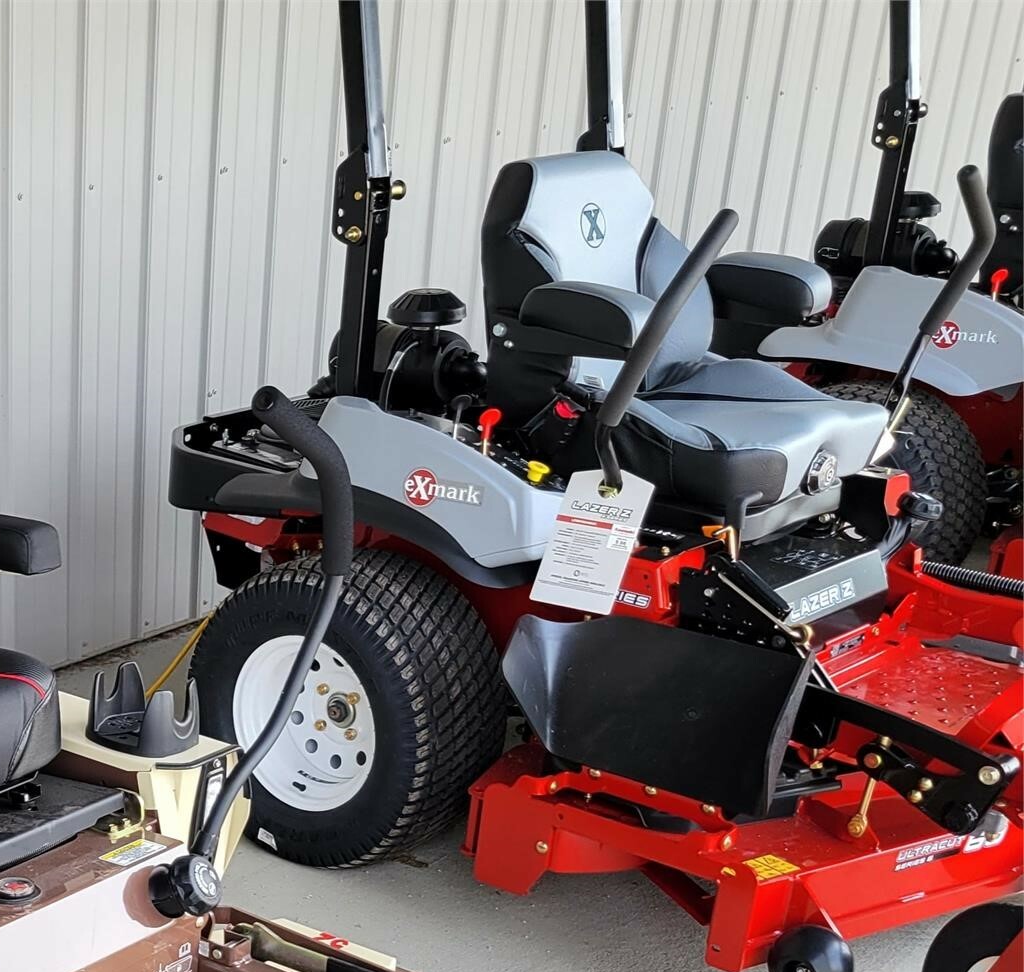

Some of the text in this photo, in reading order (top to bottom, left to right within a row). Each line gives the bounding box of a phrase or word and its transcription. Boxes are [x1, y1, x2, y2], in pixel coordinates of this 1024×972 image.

[404, 475, 481, 505] eXmark
[571, 501, 633, 518] LAZER Z
[789, 578, 855, 620] LAZER Z
[896, 836, 964, 862] ULTRACUT
